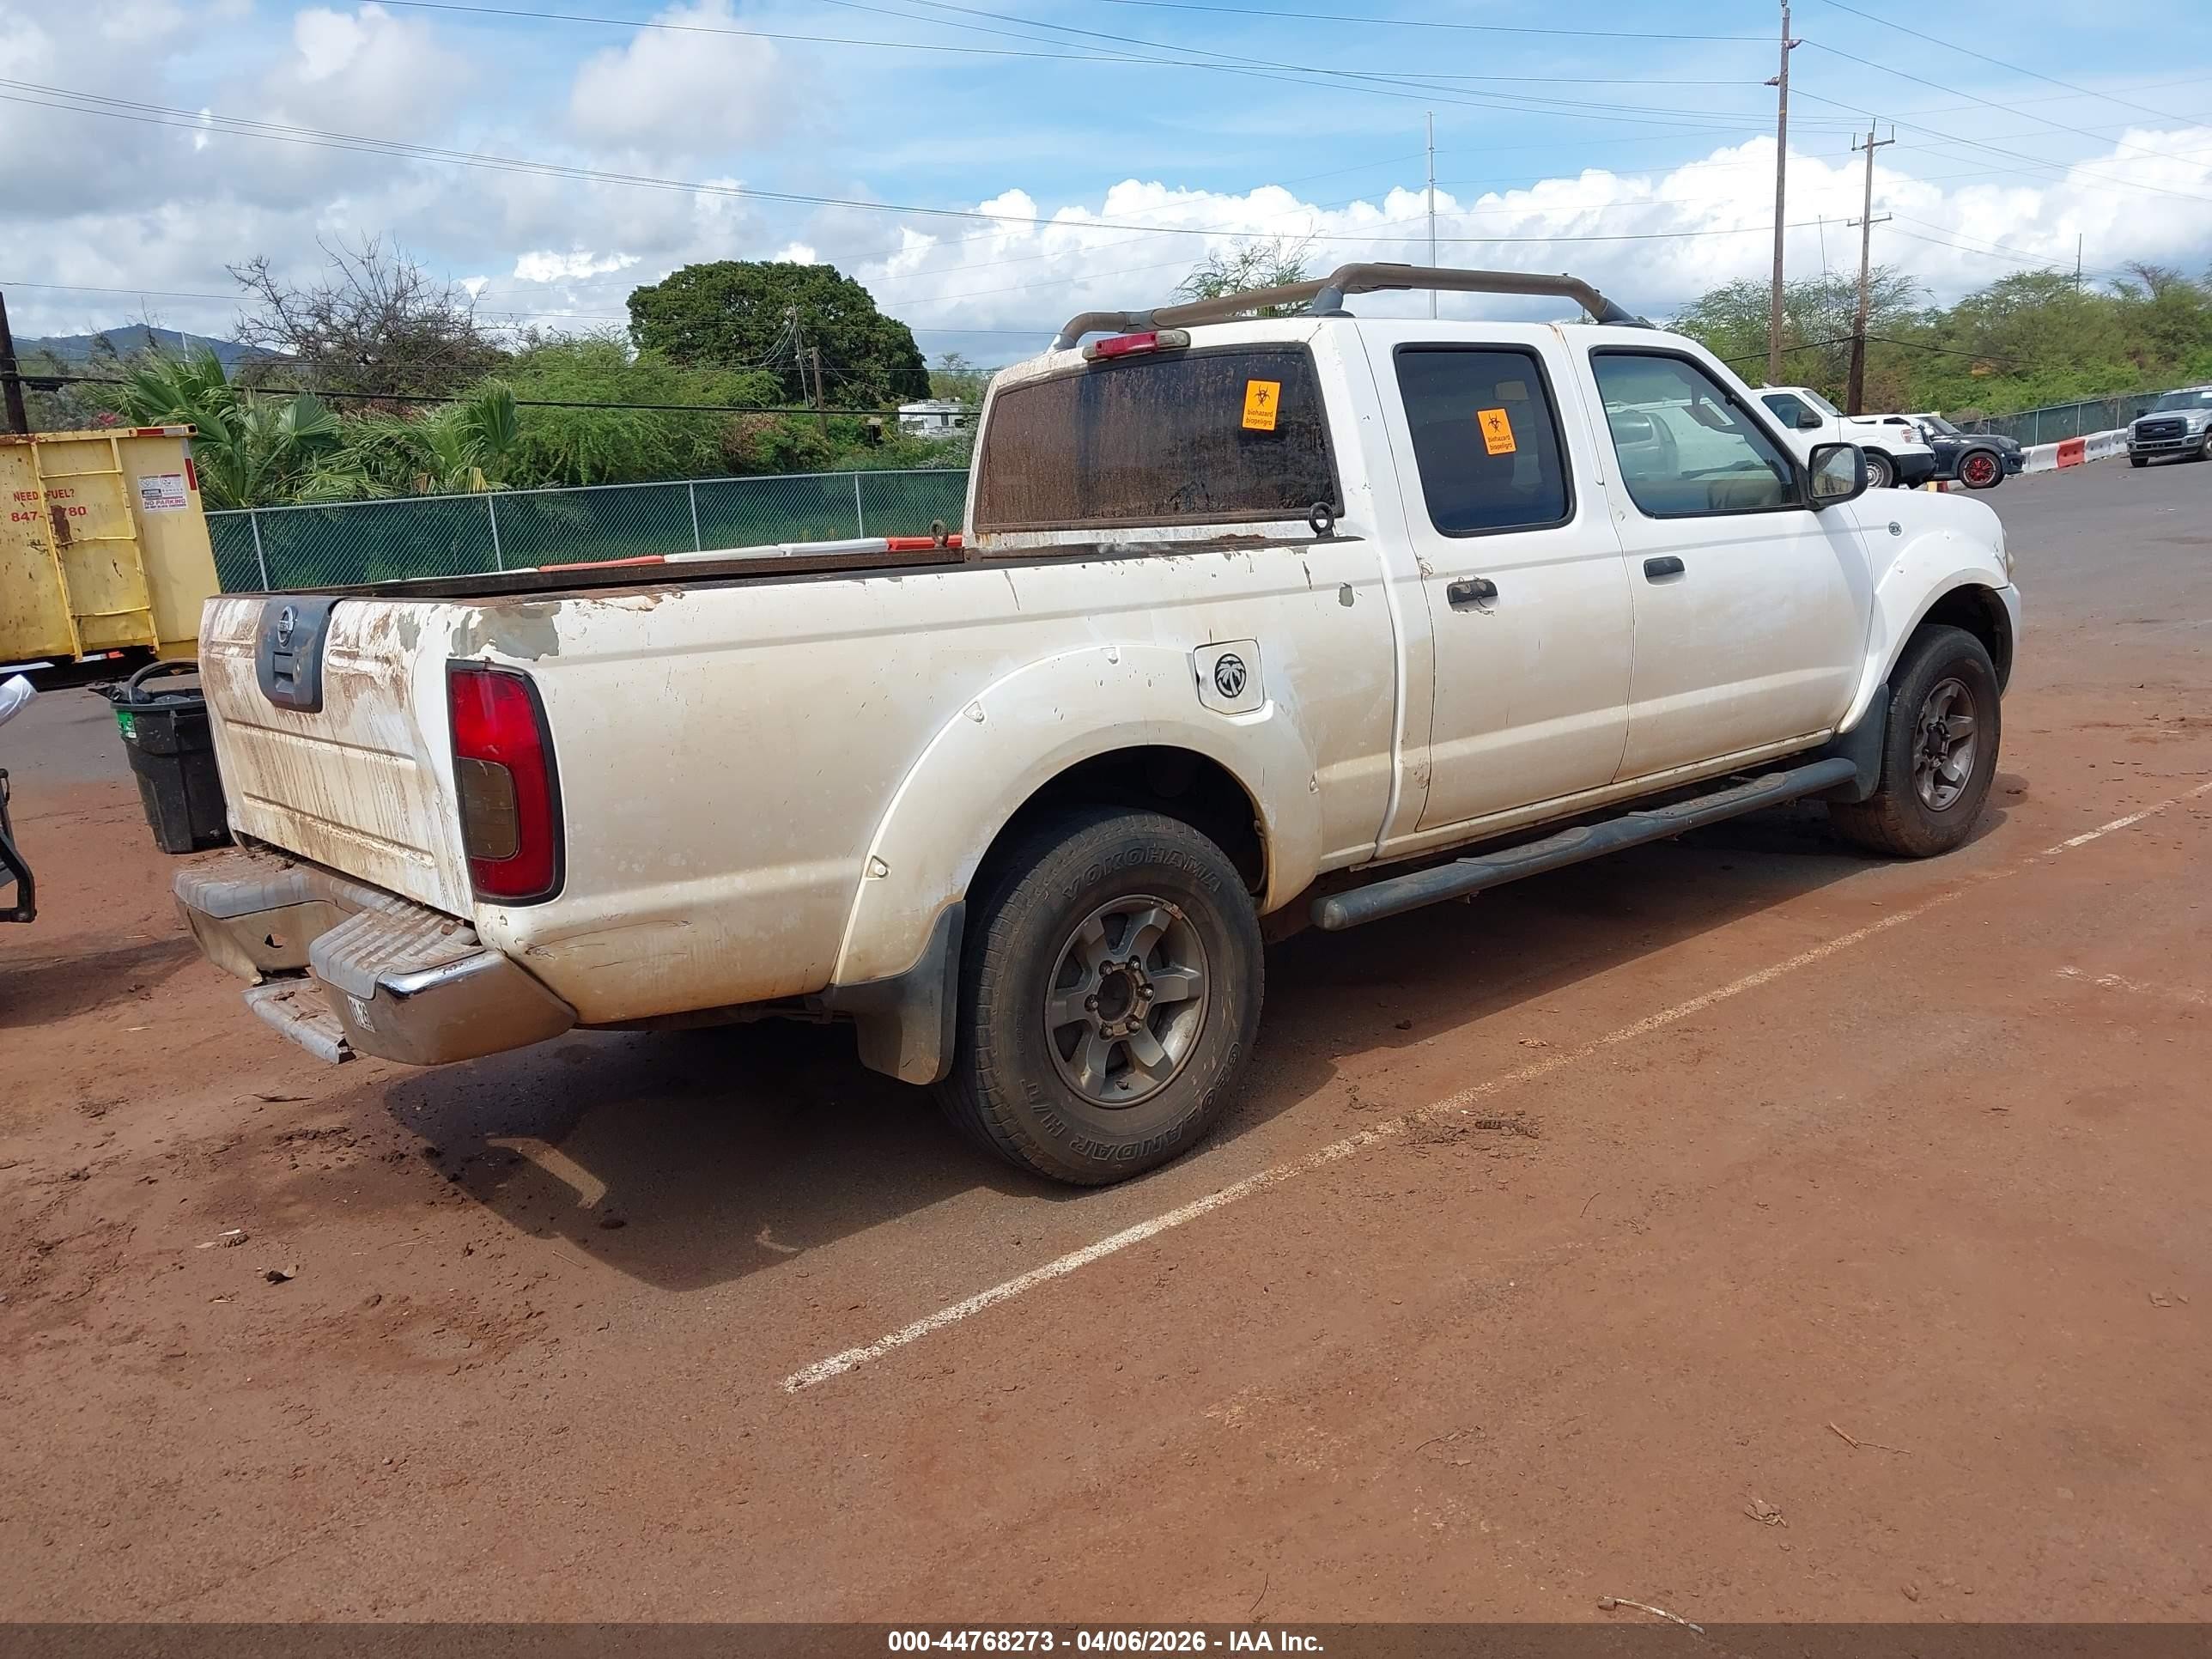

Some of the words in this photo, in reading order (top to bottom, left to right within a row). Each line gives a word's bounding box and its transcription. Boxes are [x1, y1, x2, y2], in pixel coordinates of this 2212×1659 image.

[1247, 409, 1273, 417] biohazard
[1245, 416, 1273, 427] biopeligro
[13, 491, 39, 502] NEED
[1062, 845, 1223, 901] YOKOHAMA
[1070, 1041, 1243, 1161] GEOLANDAR
